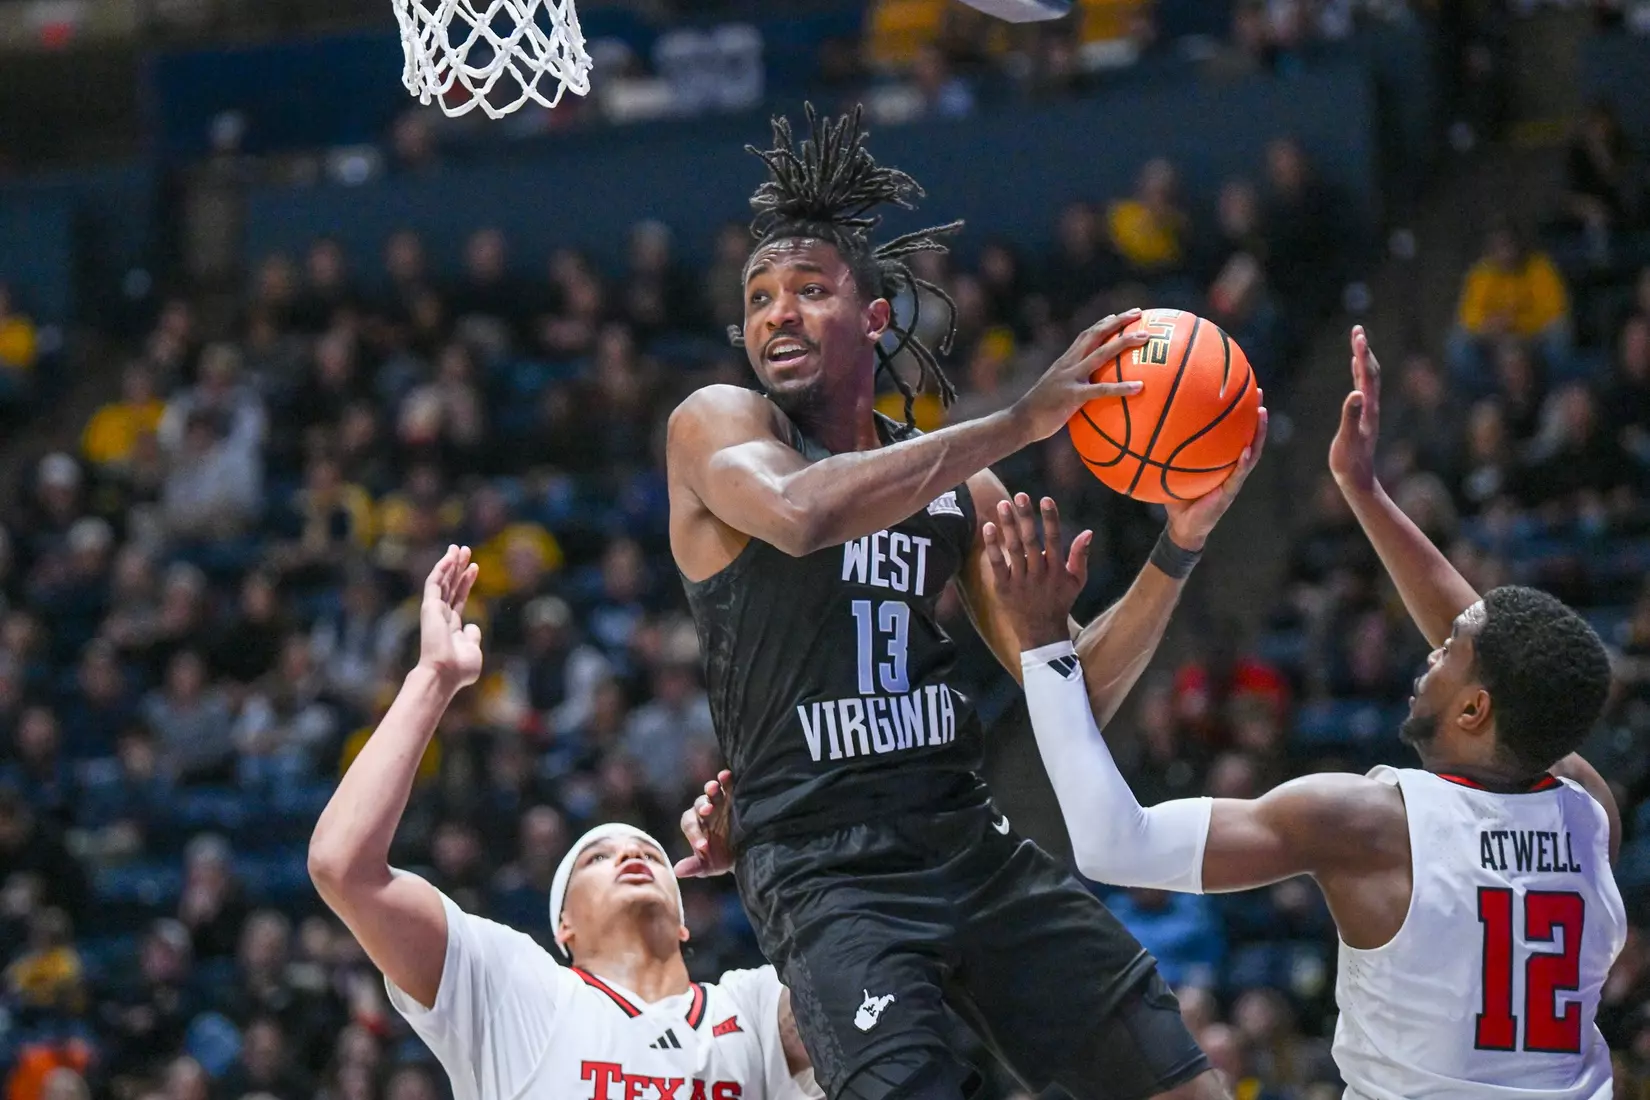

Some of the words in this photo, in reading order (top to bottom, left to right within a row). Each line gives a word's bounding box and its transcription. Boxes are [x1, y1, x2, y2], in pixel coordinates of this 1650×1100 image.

[842, 530, 932, 596] WEST
[851, 600, 910, 695] 13
[797, 683, 956, 762] VIRGINIA
[1480, 830, 1582, 873] ATWELL
[1474, 886, 1585, 1054] 12
[581, 1060, 742, 1100] TEXAS
